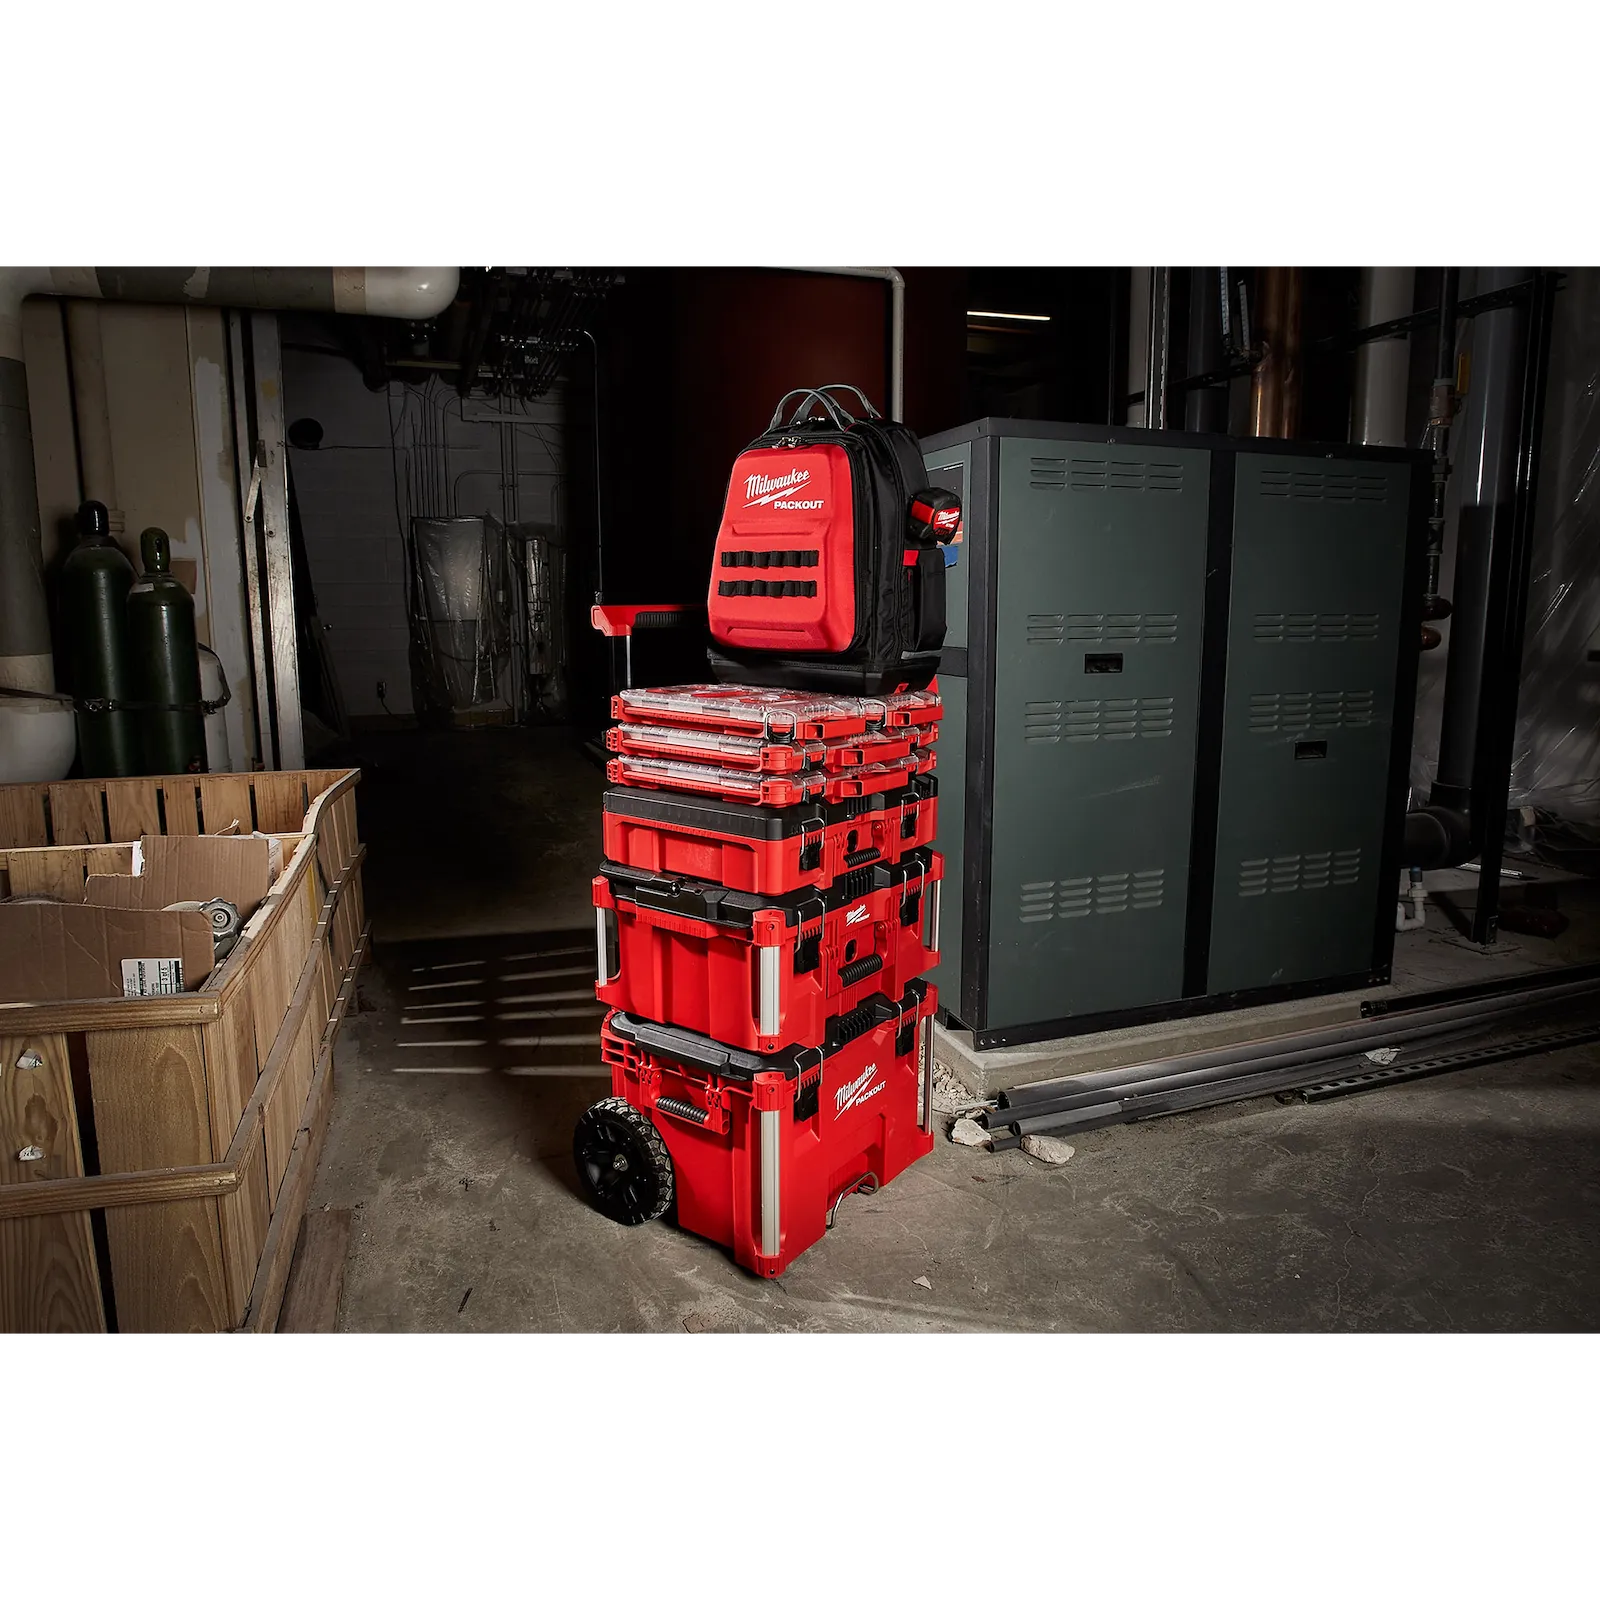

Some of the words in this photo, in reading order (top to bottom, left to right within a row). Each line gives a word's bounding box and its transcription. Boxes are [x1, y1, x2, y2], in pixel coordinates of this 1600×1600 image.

[743, 468, 810, 499] Milwaukee
[773, 500, 824, 510] PACKOUT
[855, 1080, 887, 1107] PACKOUT
